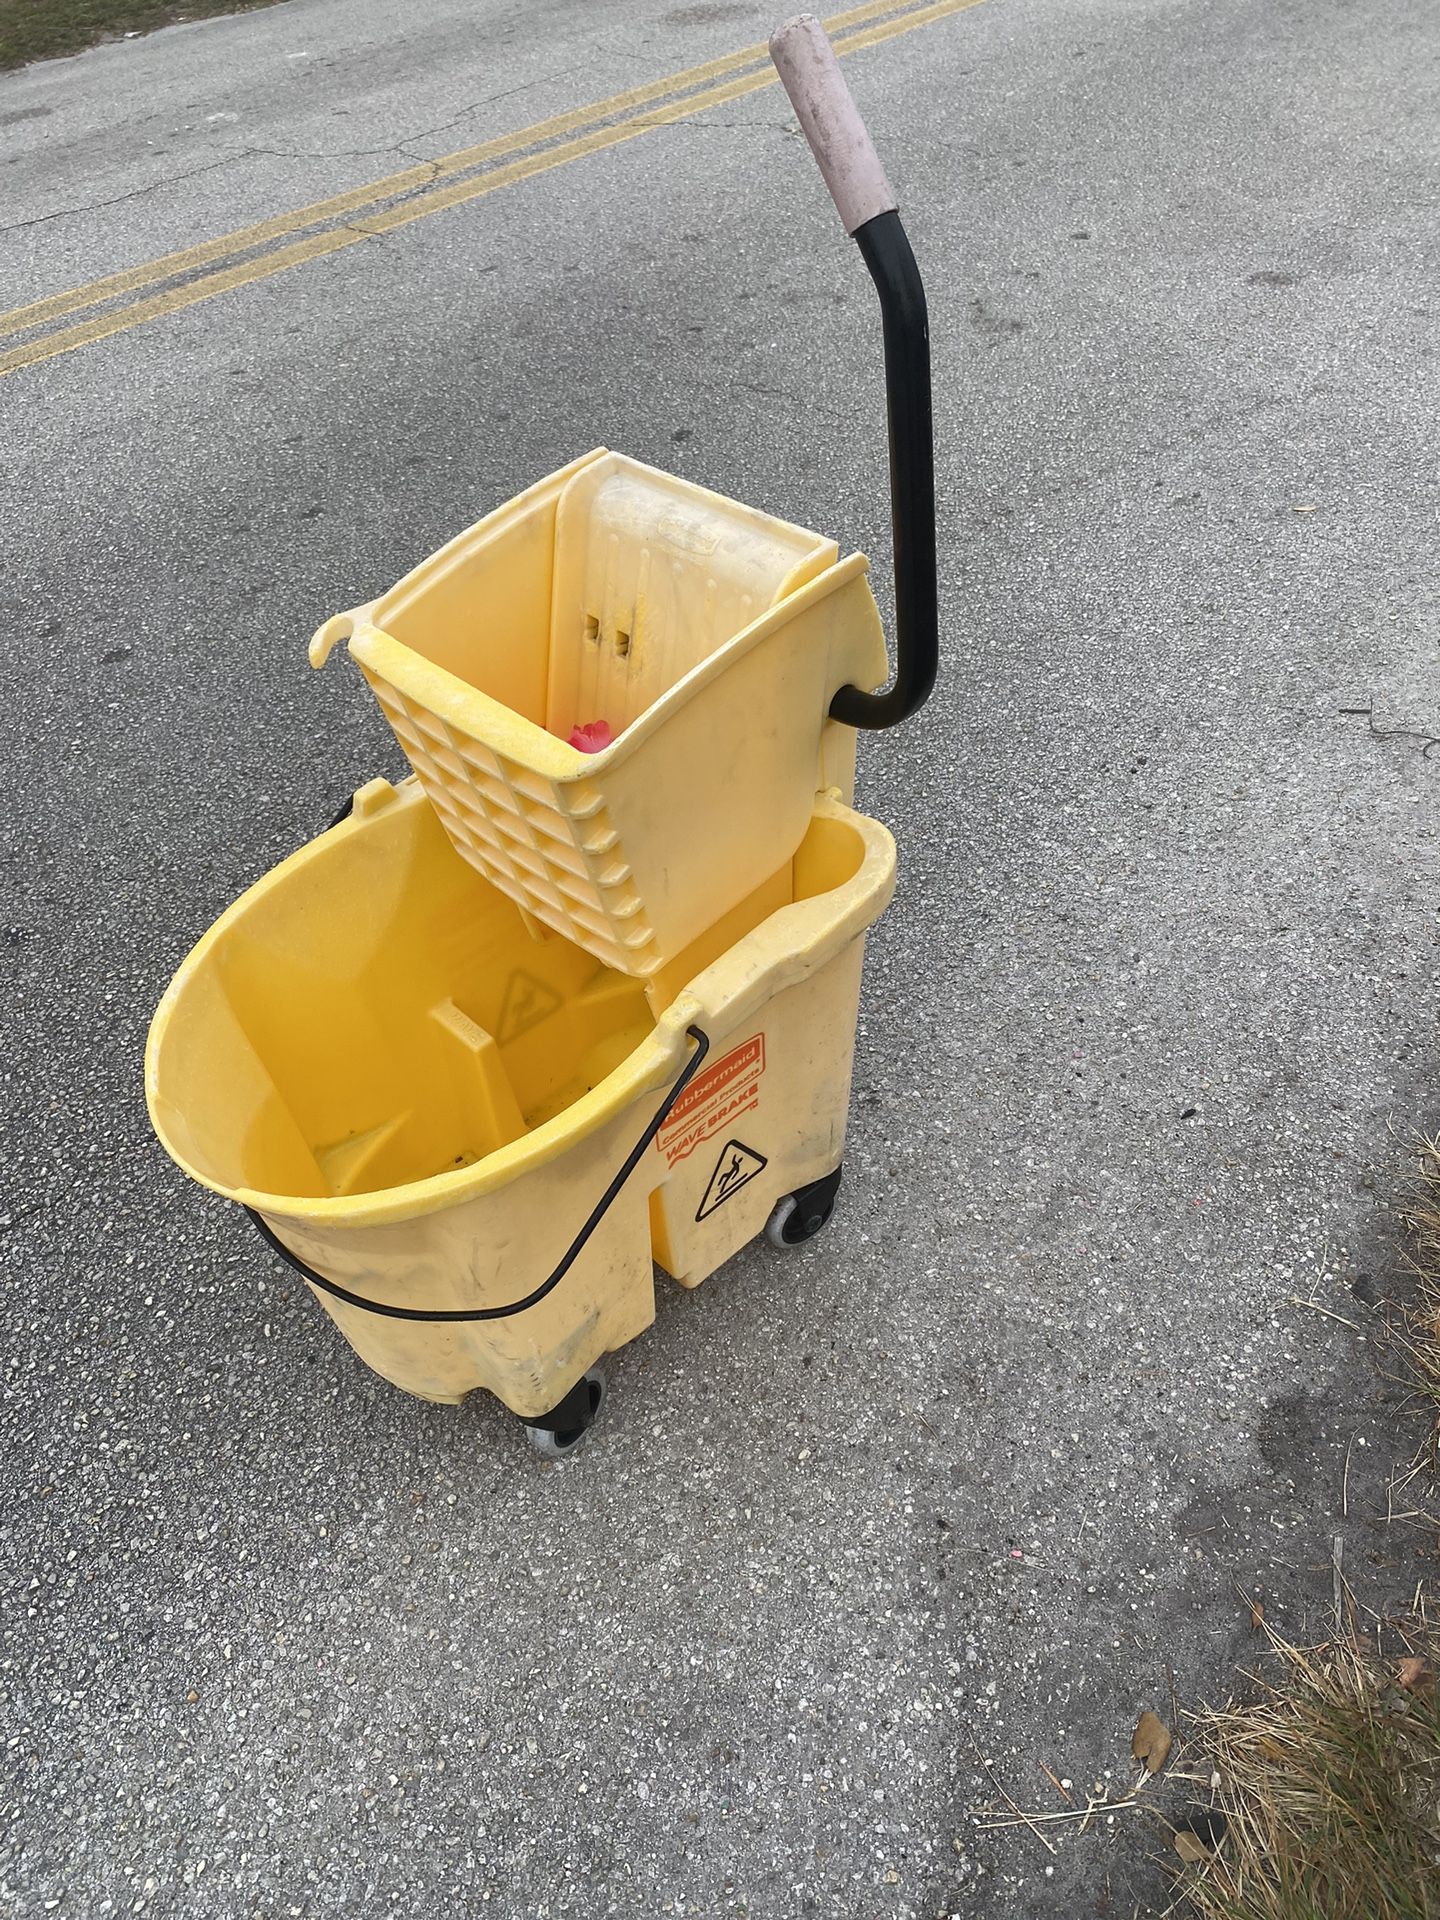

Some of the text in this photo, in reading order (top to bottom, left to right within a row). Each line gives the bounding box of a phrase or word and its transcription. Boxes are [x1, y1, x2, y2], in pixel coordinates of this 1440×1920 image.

[663, 1068, 760, 1145] Commercial Products
[666, 1082, 759, 1161] WAVE BRAKE
